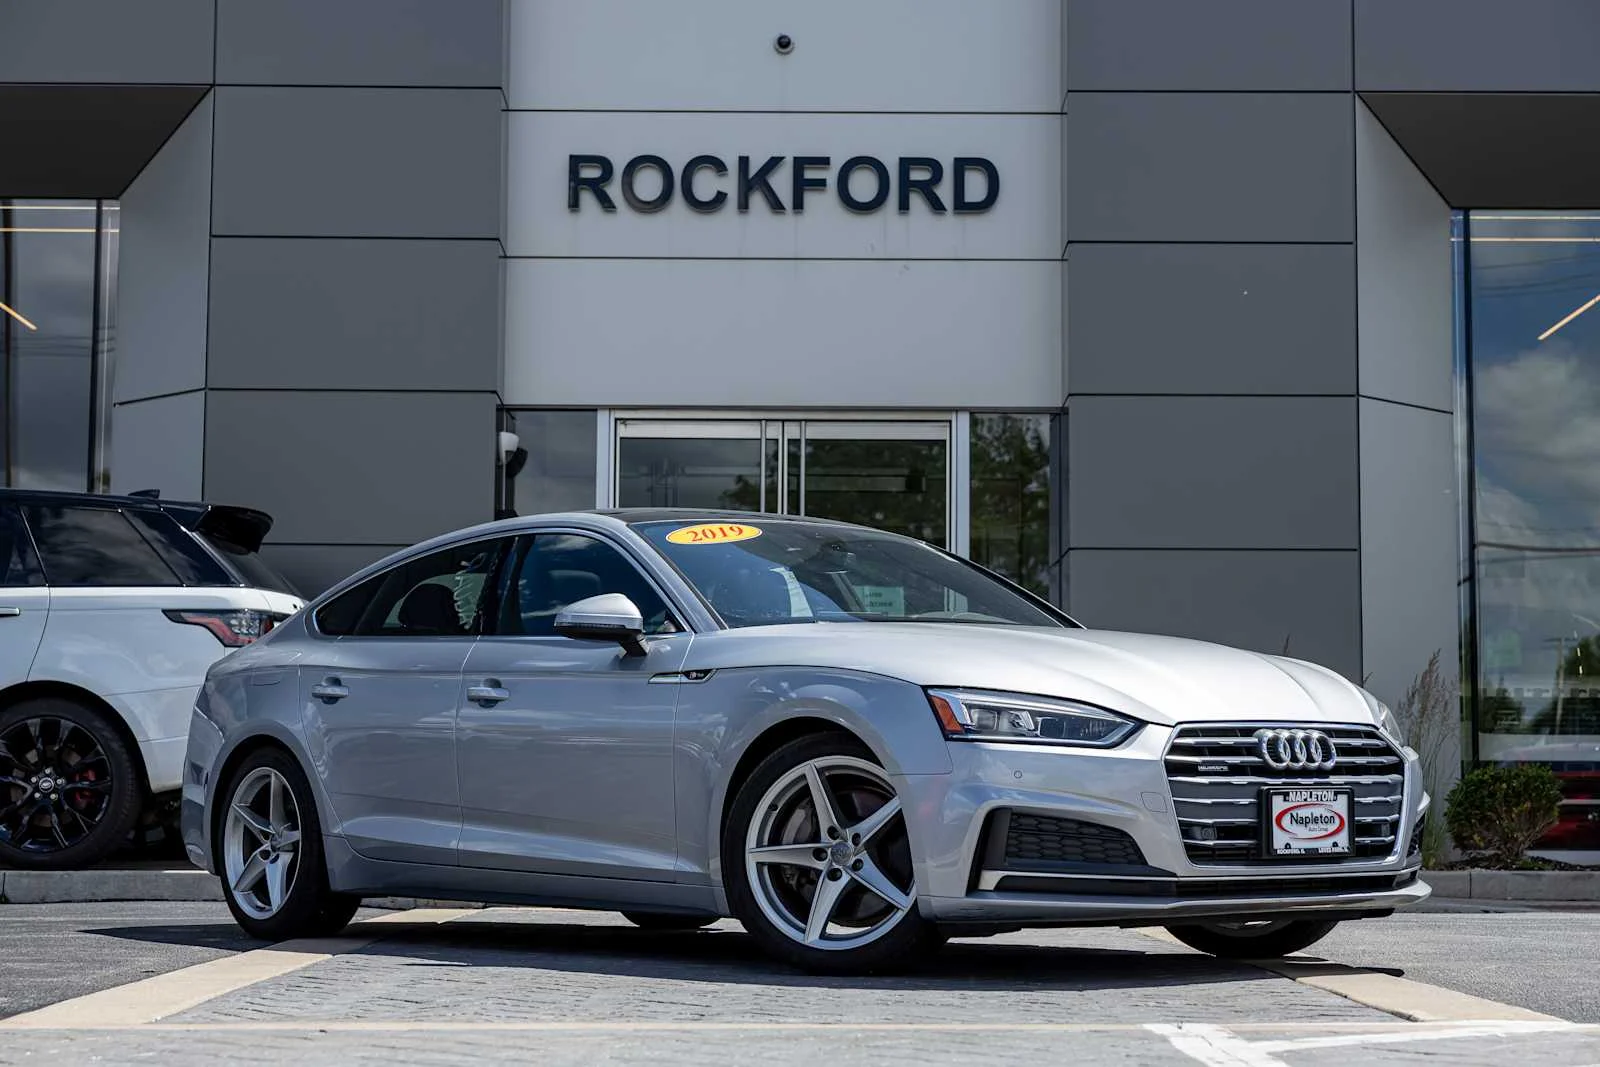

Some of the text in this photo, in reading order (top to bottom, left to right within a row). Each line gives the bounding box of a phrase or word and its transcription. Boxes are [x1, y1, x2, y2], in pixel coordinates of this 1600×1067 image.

[568, 154, 1000, 213] ROCKFORD
[686, 526, 743, 541] 2019
[1289, 791, 1335, 801] NAPLETON
[1290, 812, 1335, 827] Napleton
